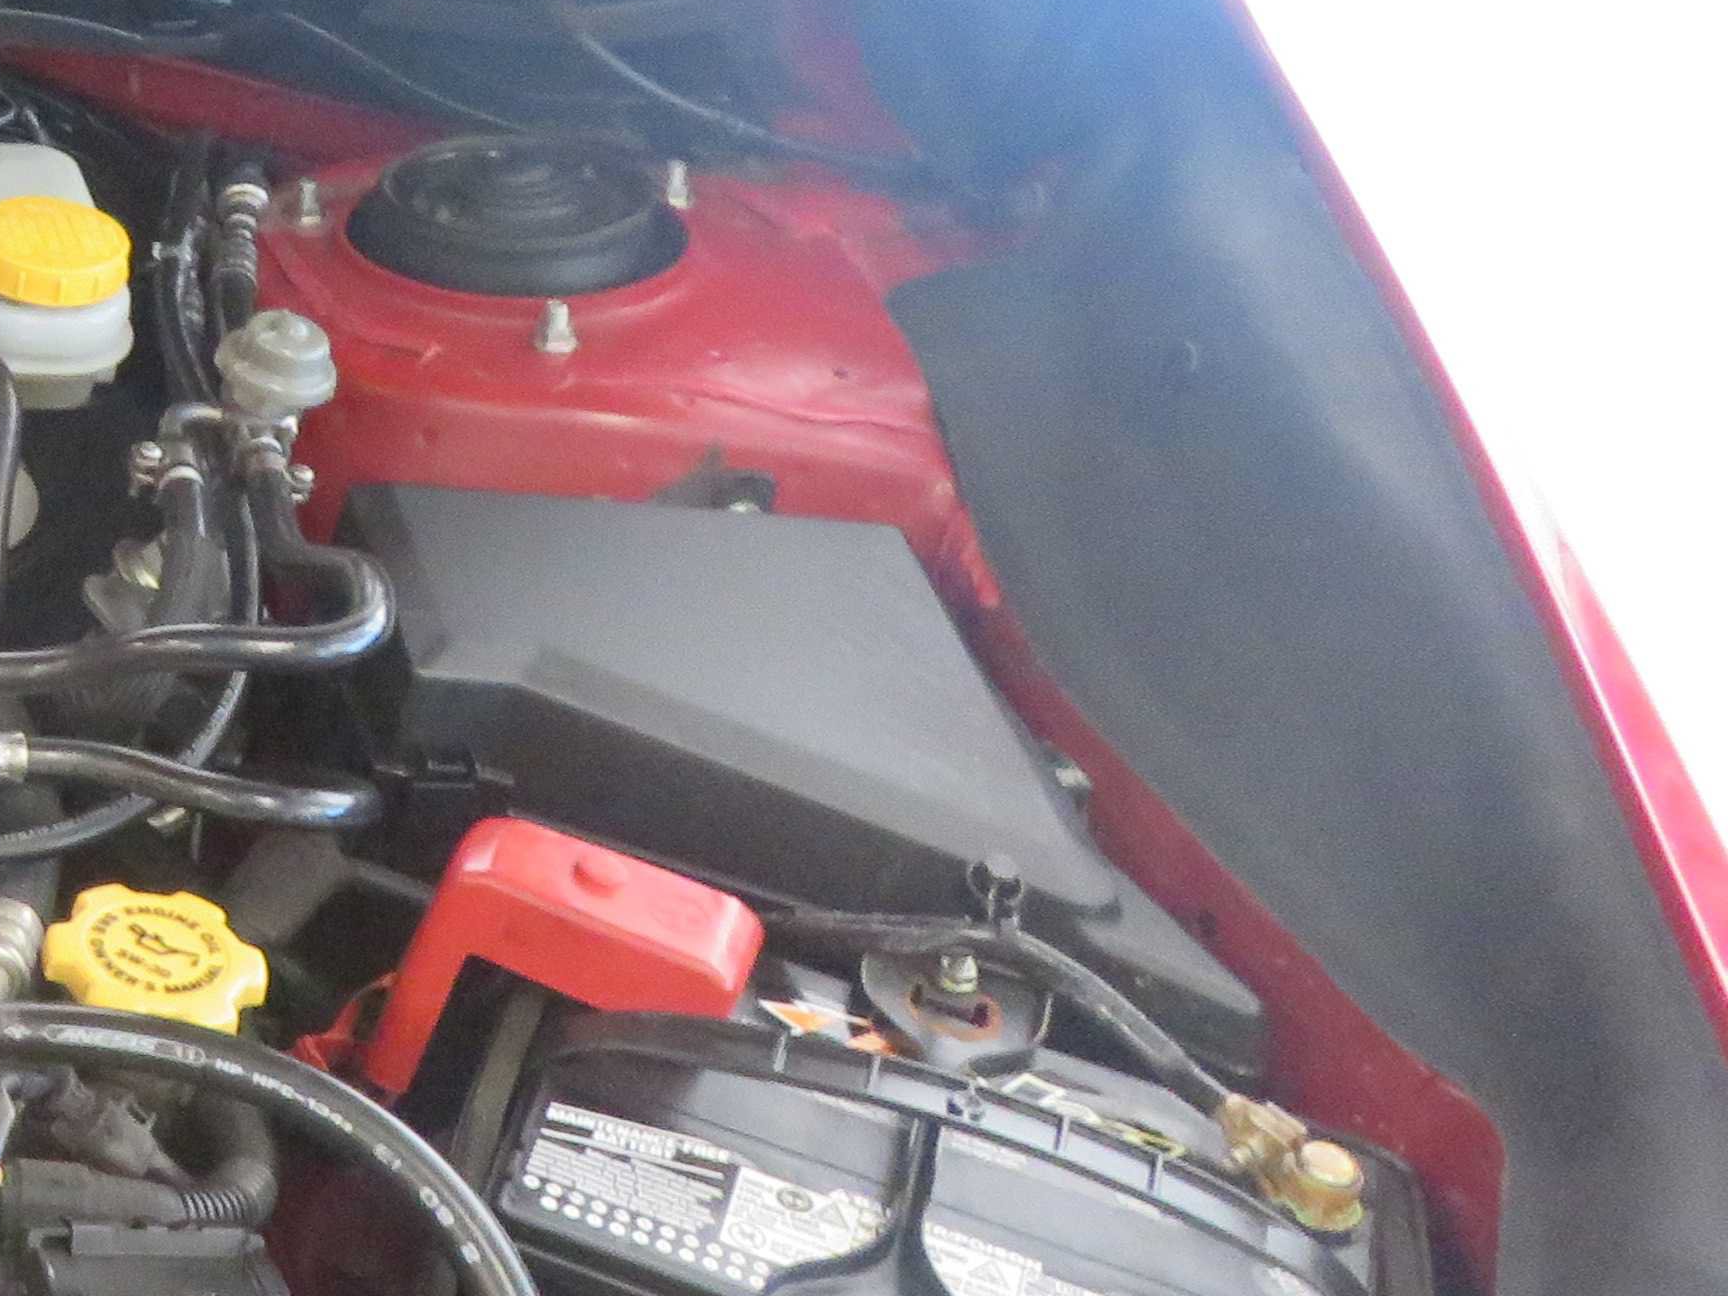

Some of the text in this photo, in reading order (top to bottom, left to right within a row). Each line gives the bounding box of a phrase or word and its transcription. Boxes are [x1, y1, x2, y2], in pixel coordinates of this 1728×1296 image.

[123, 904, 201, 930] ENGINE
[163, 964, 225, 994] MANUAL
[591, 1130, 677, 1159] BATTERY
